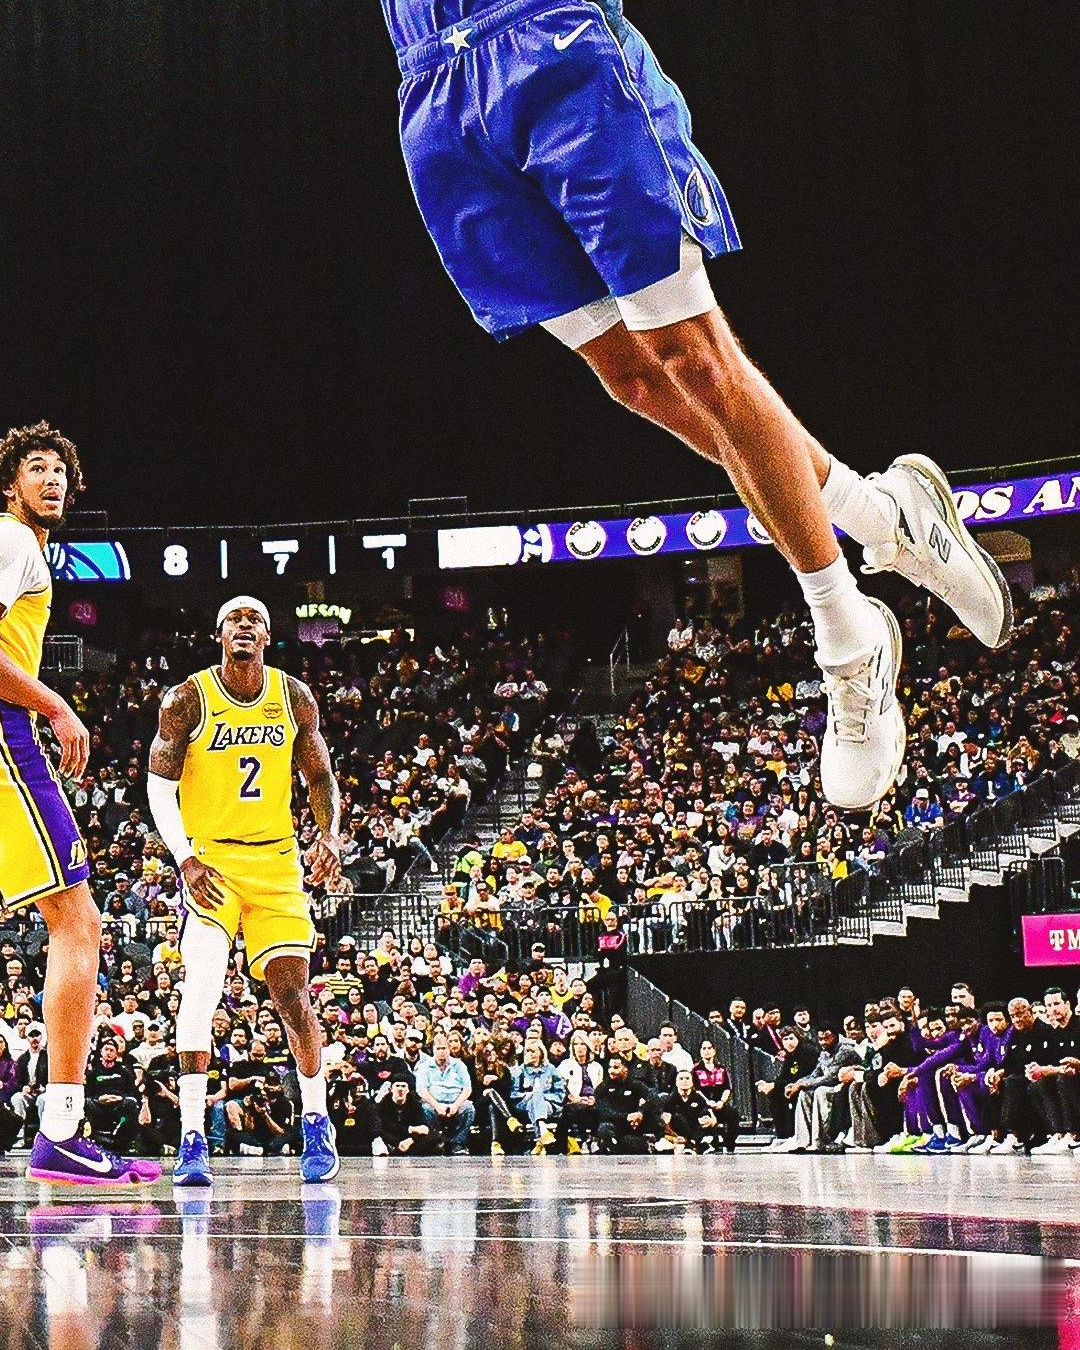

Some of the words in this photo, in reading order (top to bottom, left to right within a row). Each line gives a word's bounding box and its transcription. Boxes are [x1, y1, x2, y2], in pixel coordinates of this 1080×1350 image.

[952, 486, 1015, 520] OS
[163, 544, 189, 576] 8
[273, 553, 290, 575] 7
[381, 547, 395, 570] 1
[206, 721, 286, 751] LAKERS
[239, 756, 261, 799] 2
